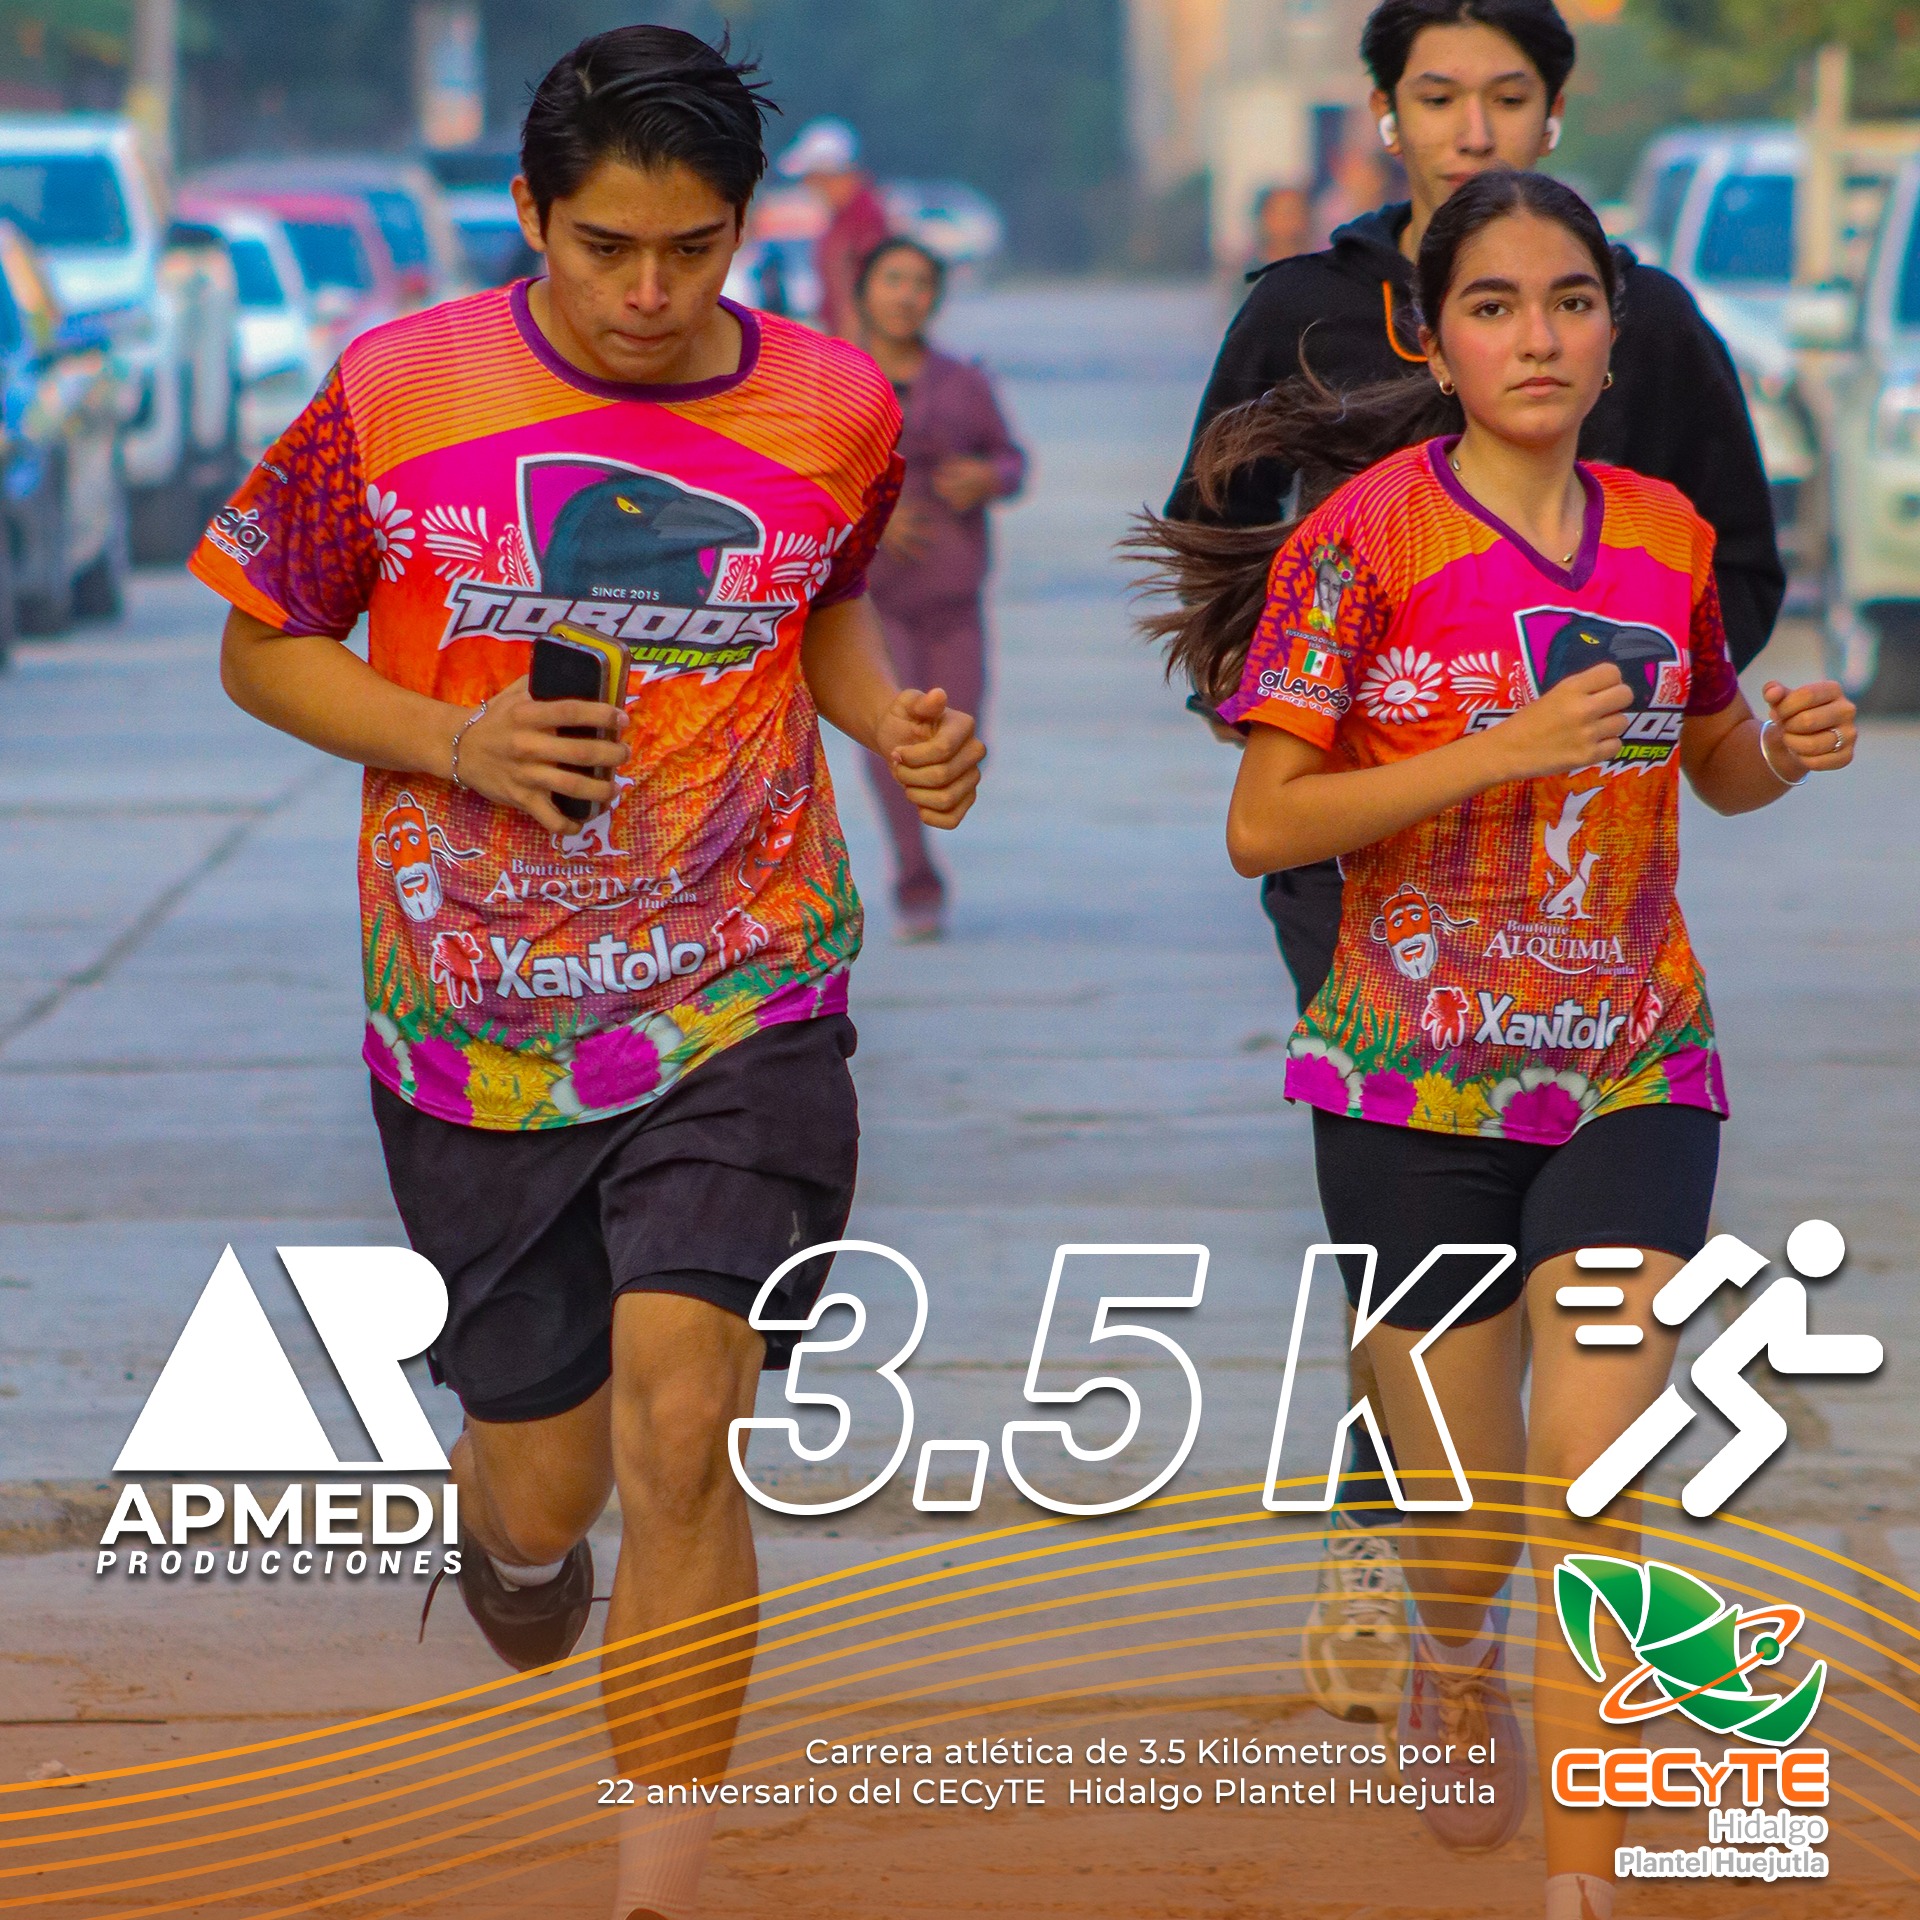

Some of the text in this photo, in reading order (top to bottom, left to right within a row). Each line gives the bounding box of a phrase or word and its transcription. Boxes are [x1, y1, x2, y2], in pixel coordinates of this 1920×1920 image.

[591, 586, 660, 601] SINCE 2015
[511, 858, 595, 879] Boutique
[1507, 920, 1569, 937] Boutique
[489, 925, 706, 999] Xantolo
[1483, 930, 1625, 974] ALQUIMIA
